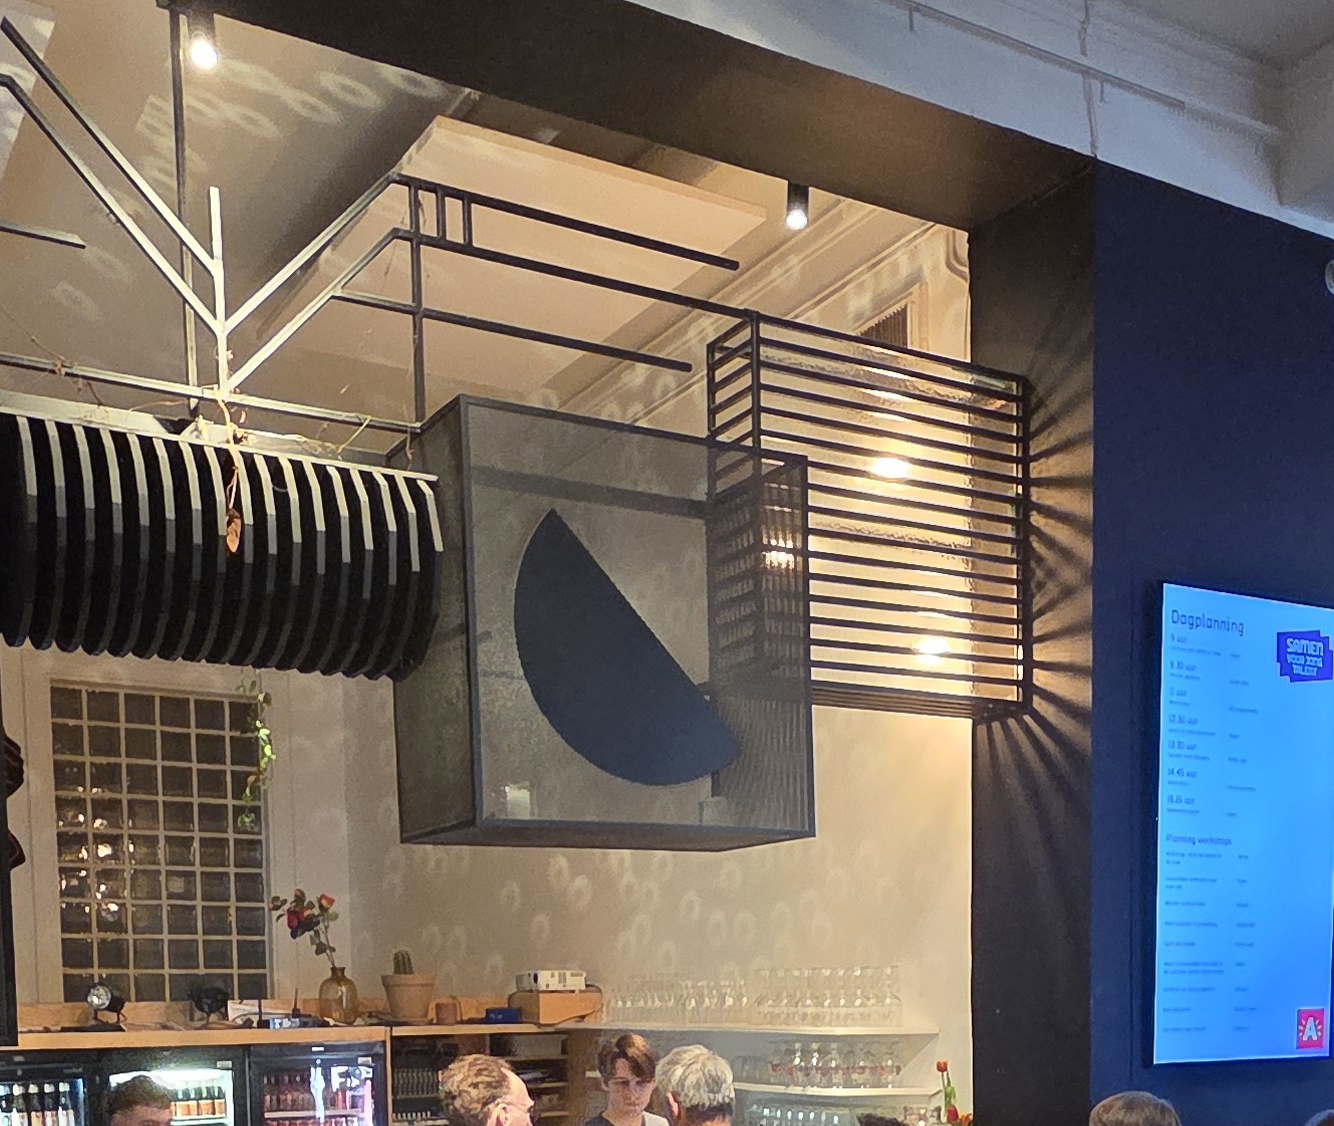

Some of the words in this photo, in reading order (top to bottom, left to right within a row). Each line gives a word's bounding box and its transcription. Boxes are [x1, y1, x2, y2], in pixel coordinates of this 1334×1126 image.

[1171, 609, 1245, 637] Dagplanning
[1286, 637, 1324, 657] SAMEN
[1302, 1016, 1318, 1041] A
